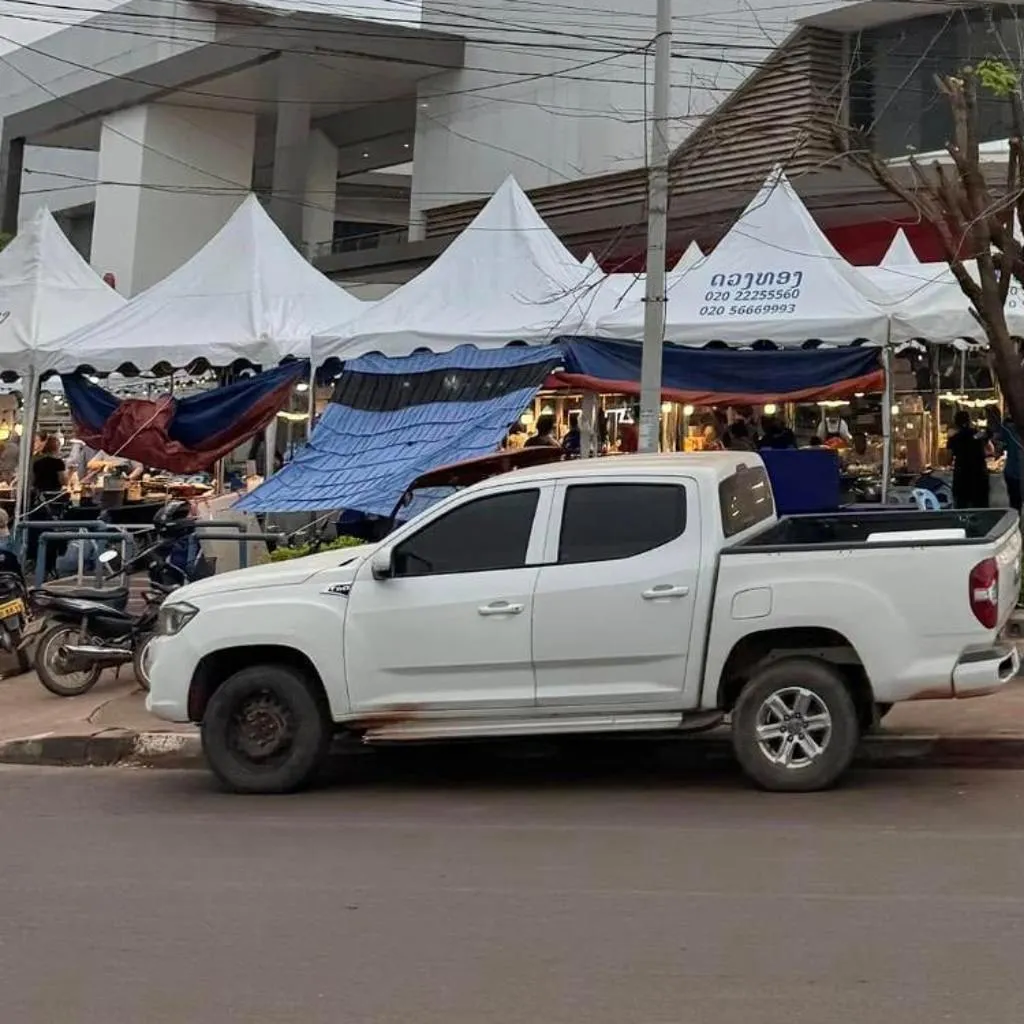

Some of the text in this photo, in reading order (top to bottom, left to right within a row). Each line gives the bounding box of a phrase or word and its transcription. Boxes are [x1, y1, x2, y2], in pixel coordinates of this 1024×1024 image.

[705, 289, 800, 301] 020 22255560
[699, 304, 796, 316] 020 56669993
